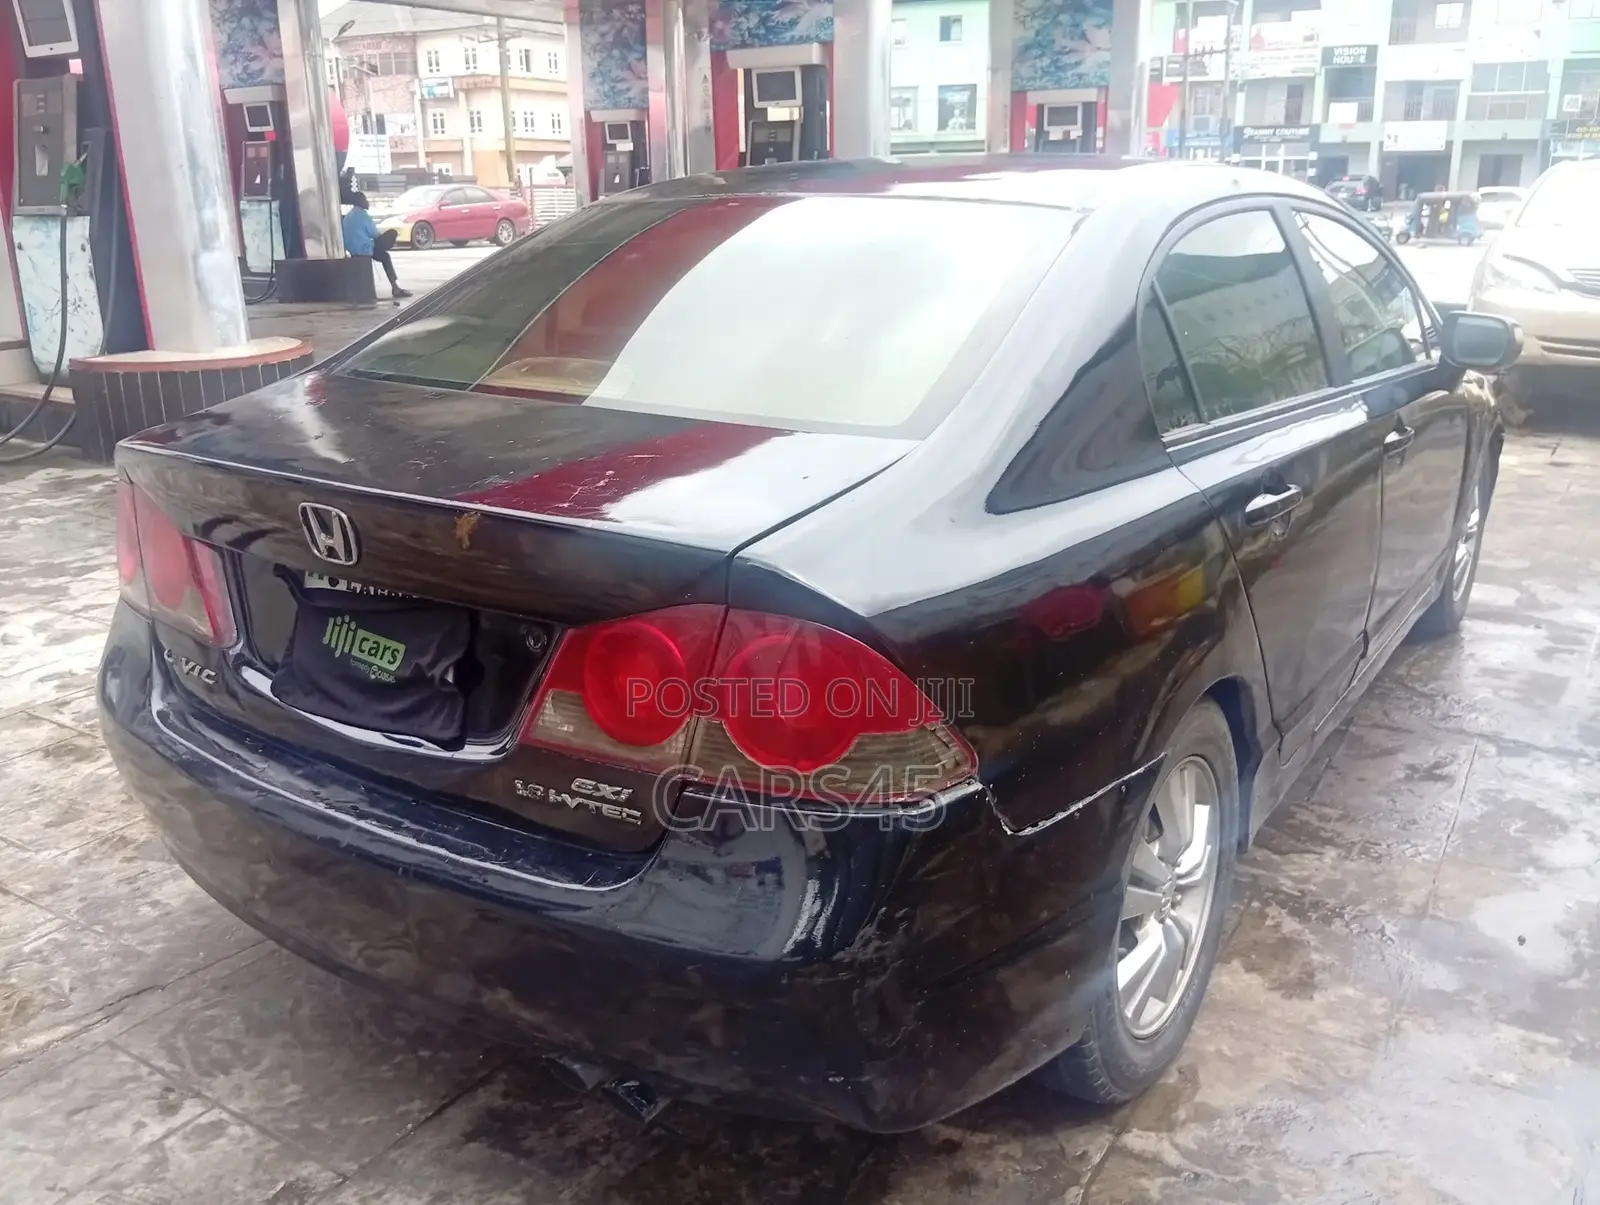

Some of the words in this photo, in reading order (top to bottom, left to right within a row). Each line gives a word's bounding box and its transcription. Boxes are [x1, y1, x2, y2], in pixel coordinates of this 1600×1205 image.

[1333, 46, 1367, 56] VISION
[1332, 54, 1367, 64] HOUE
[358, 636, 401, 666] cars
